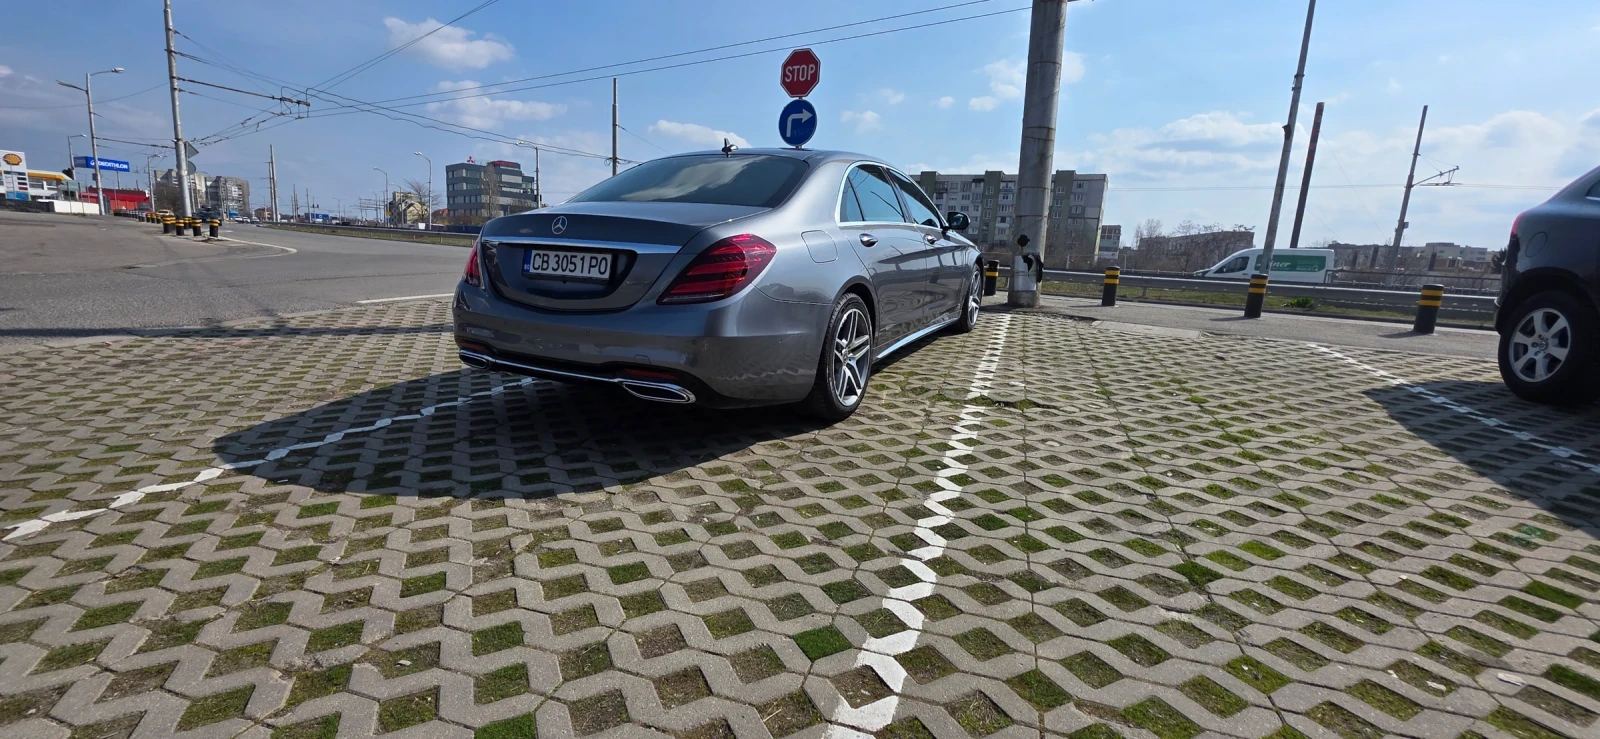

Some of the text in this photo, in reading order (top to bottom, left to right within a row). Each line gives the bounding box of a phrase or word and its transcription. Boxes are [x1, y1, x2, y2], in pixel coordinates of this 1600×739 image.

[785, 64, 815, 82] STOP
[98, 161, 128, 169] DECATHLON
[532, 253, 550, 271] CB
[551, 254, 585, 274] 3051
